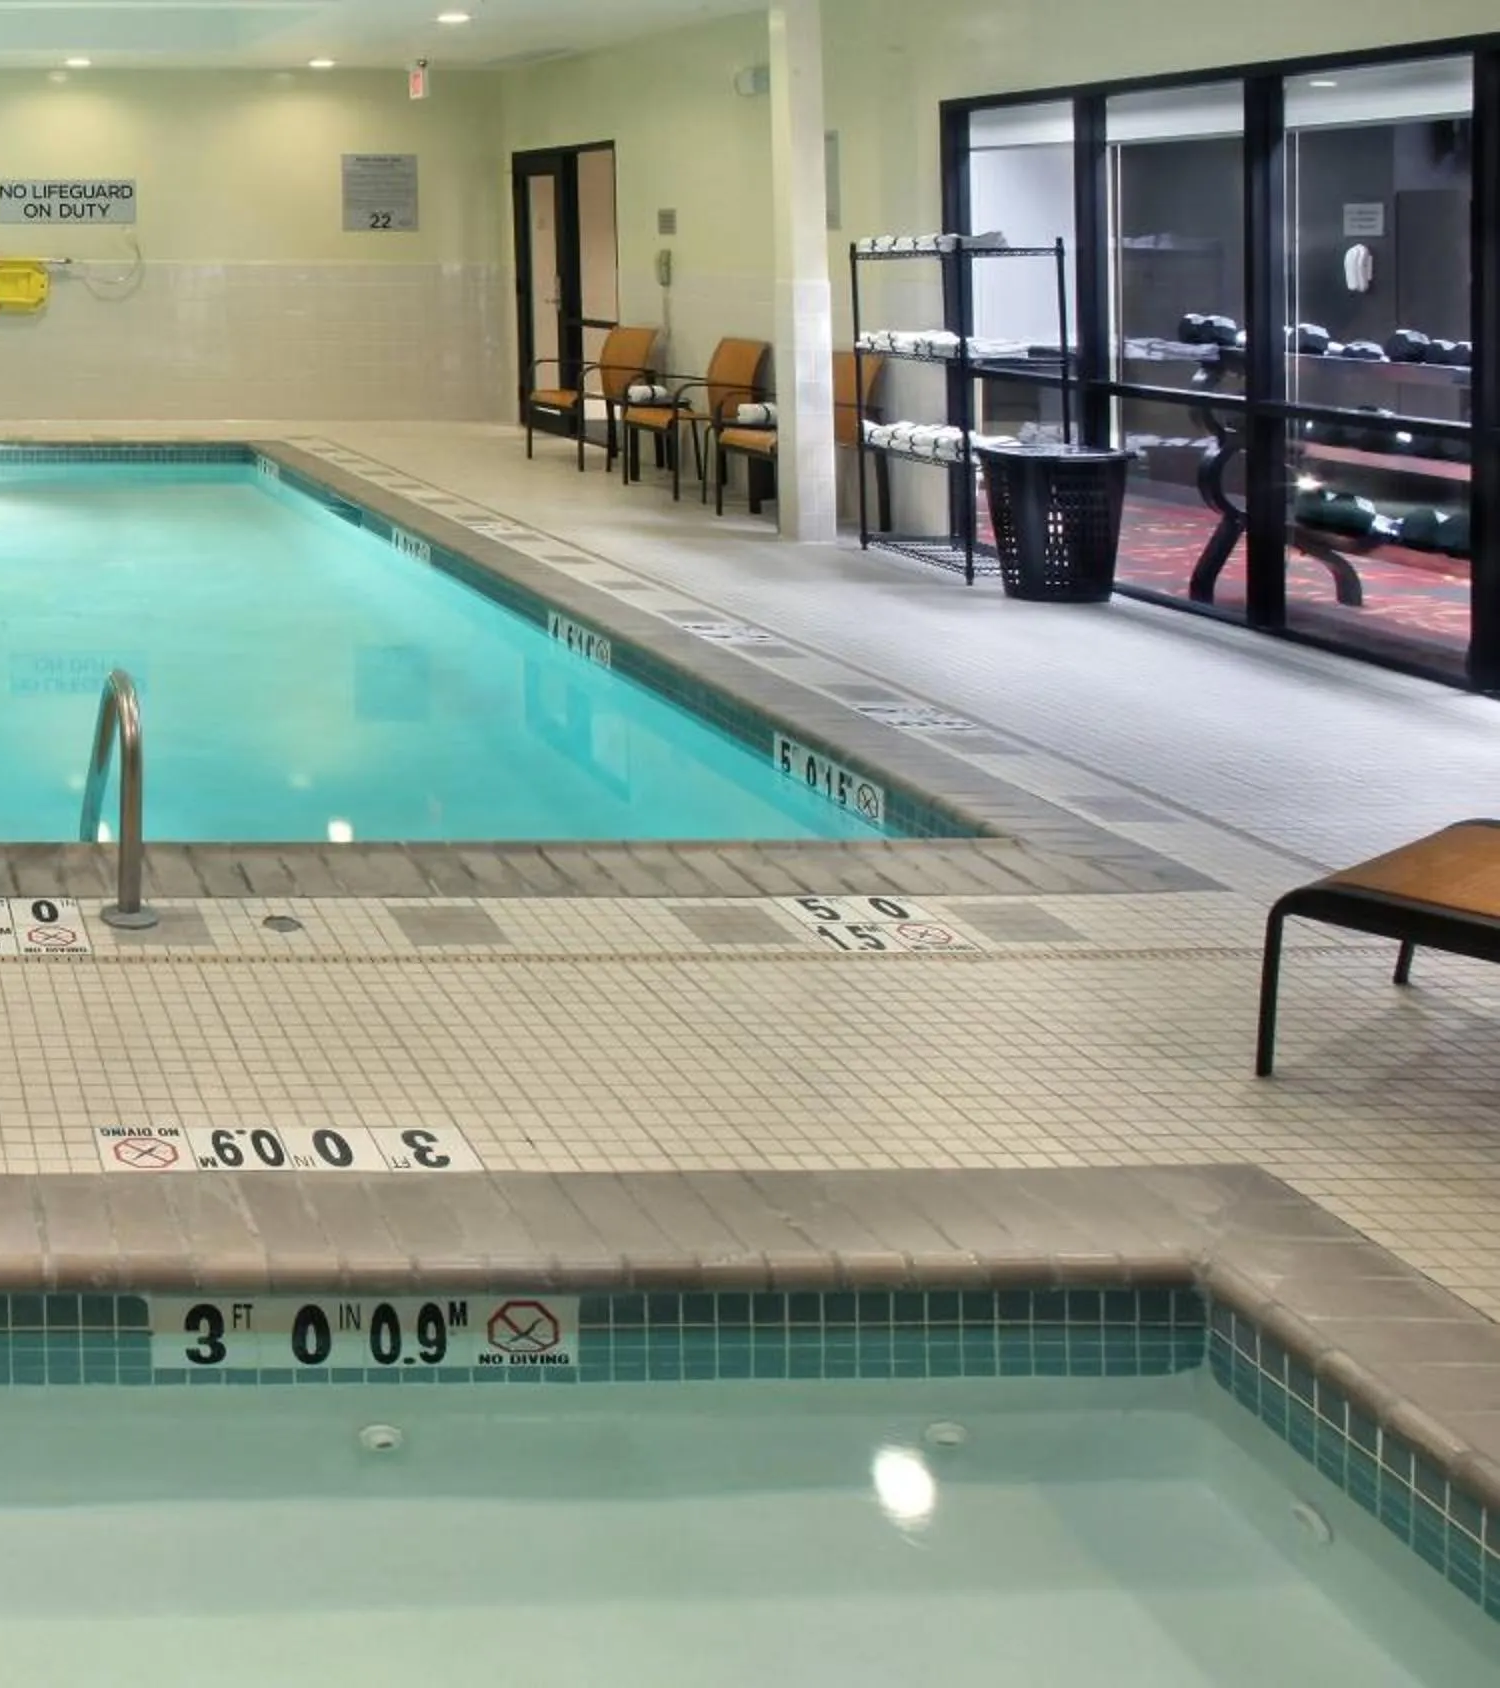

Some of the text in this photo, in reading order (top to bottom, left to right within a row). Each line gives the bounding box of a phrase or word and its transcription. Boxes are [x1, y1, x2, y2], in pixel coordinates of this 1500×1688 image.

[0, 184, 133, 199] NO LIFEGUARD
[23, 203, 110, 218] ON DUTY
[370, 212, 391, 229] 22
[781, 740, 790, 773] 5
[807, 754, 817, 787] 0
[31, 900, 59, 923] 0
[796, 898, 910, 920] 5 0
[100, 1127, 180, 1137] NO DIVING
[199, 1129, 451, 1169] 3 FT 0 IN 0.9 M
[184, 1301, 468, 1365] 3 FT 0 IN 0.9 M
[478, 1354, 569, 1365] NO DIVING
